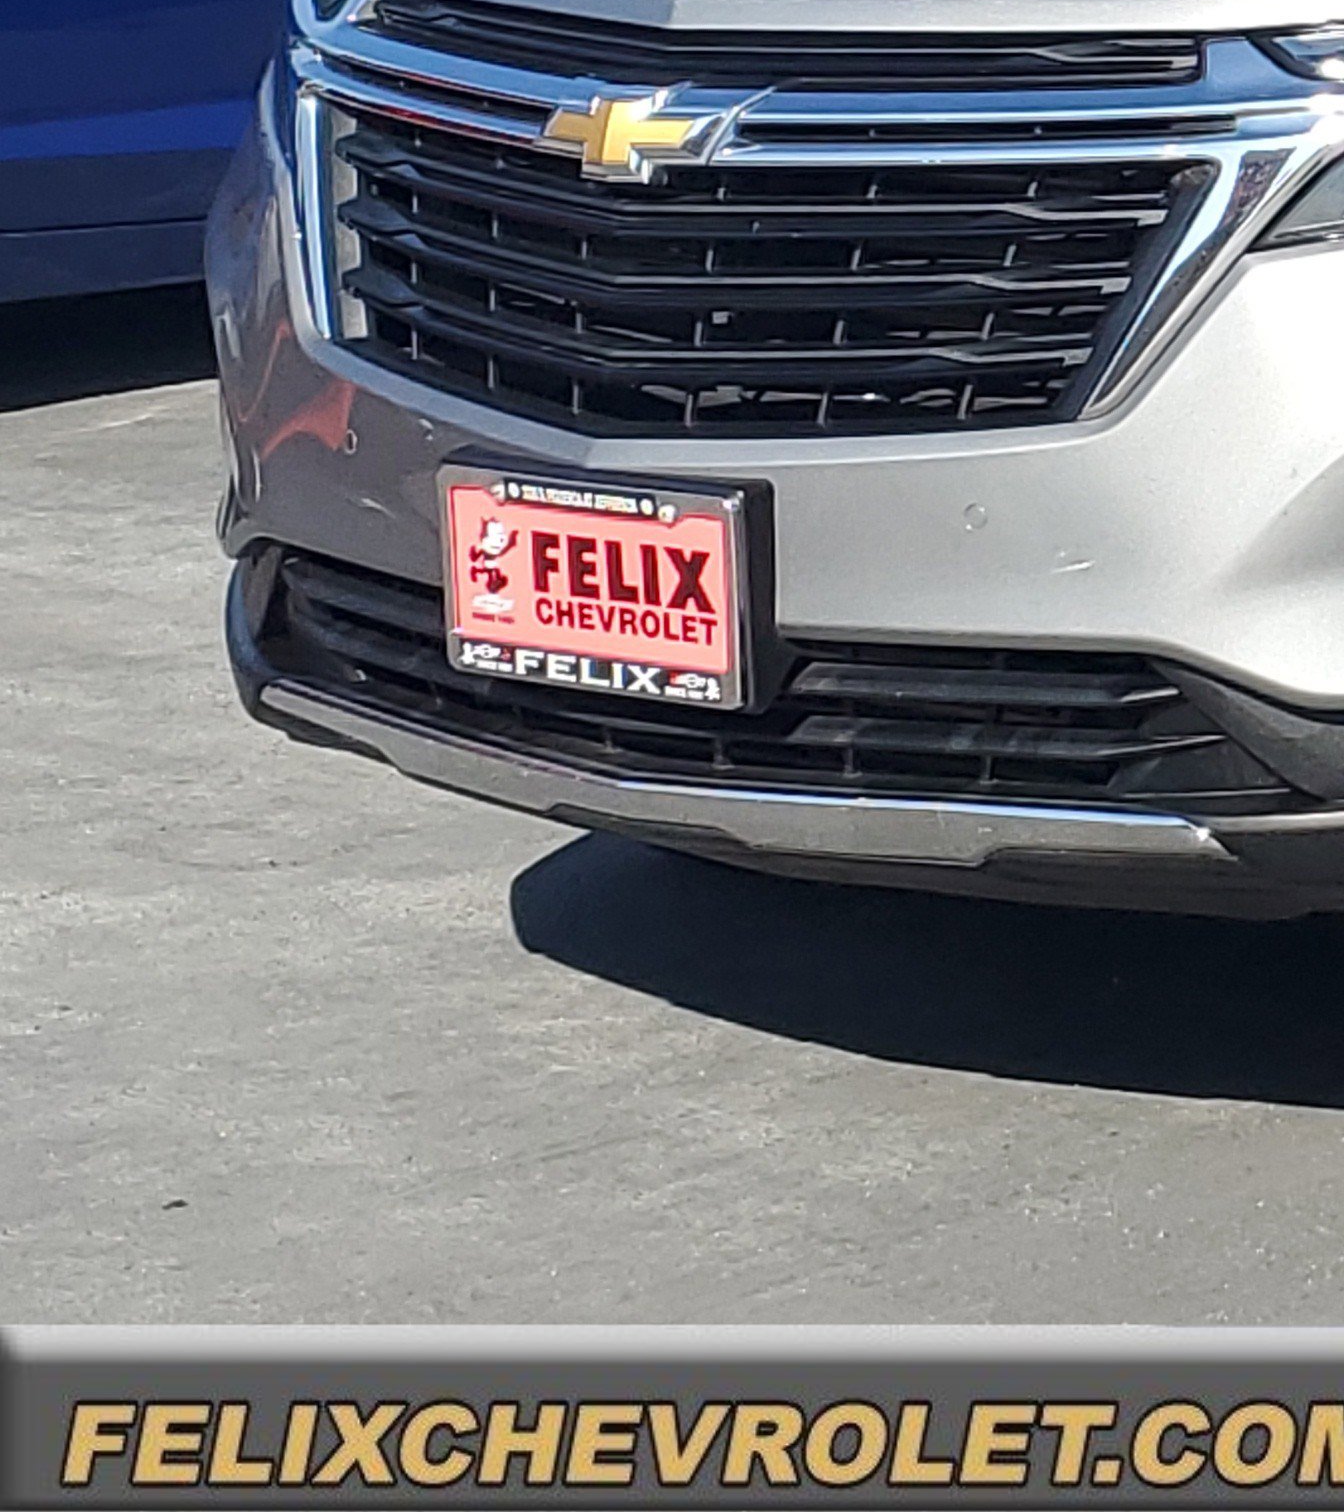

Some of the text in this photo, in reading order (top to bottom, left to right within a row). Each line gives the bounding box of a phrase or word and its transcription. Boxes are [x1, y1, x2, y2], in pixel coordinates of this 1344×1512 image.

[530, 530, 717, 615] FELIX
[535, 596, 719, 647] CHEVROLET
[514, 648, 662, 696] FELIX
